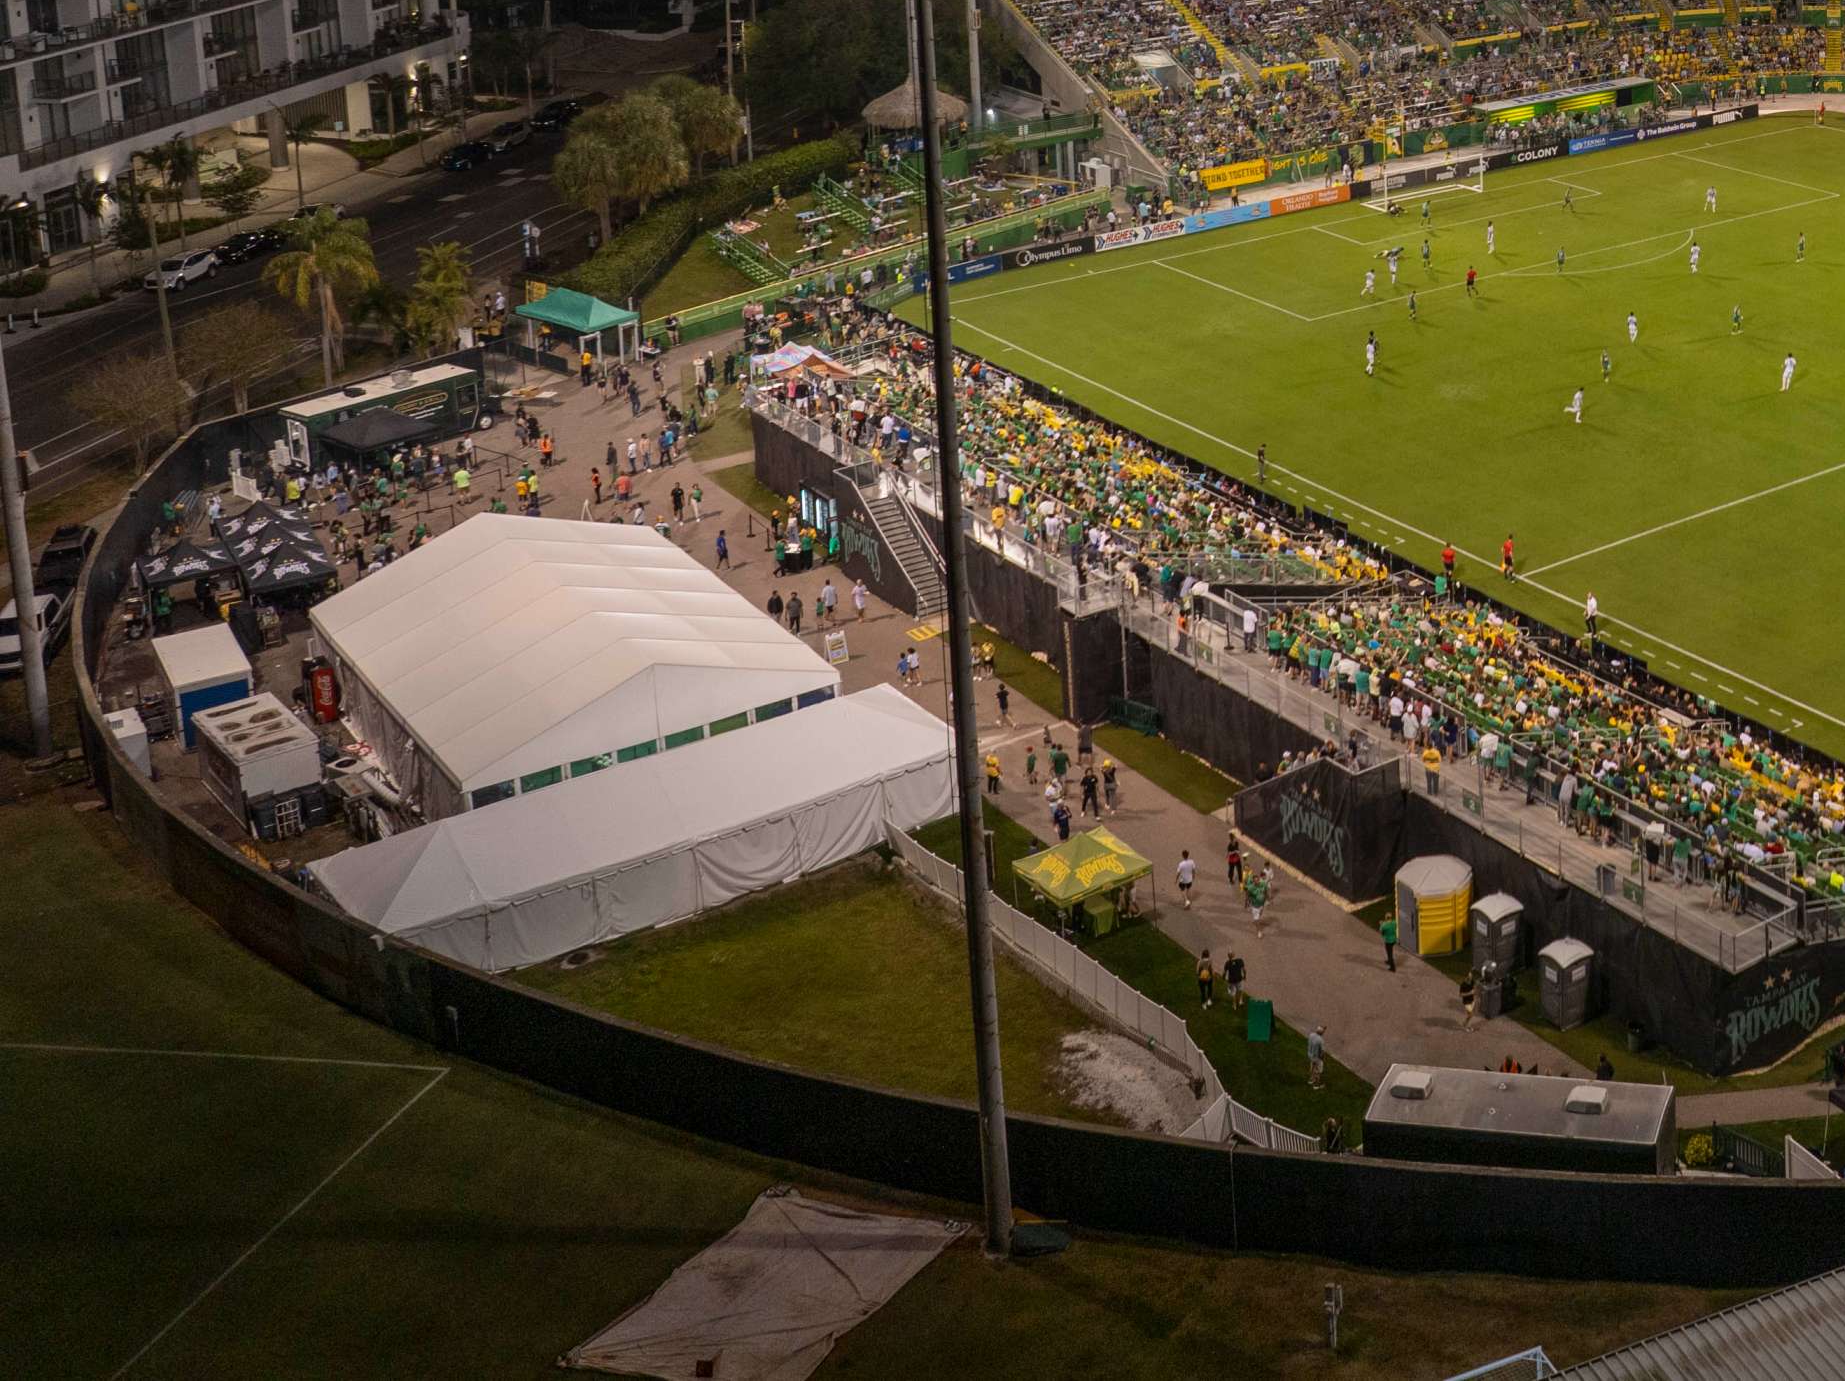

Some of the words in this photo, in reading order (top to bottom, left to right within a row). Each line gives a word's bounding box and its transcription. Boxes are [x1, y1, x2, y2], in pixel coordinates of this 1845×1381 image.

[1646, 129, 1657, 137] The
[1679, 121, 1697, 132] Group
[1517, 145, 1559, 163] COLONY
[1281, 194, 1314, 206] ORLANDO
[1152, 220, 1180, 234] HUGHES
[1105, 229, 1133, 243] HUGHES
[1021, 247, 1061, 265] Olympus
[1062, 243, 1083, 257] Limo
[1726, 977, 1821, 1066] ROWDIES
